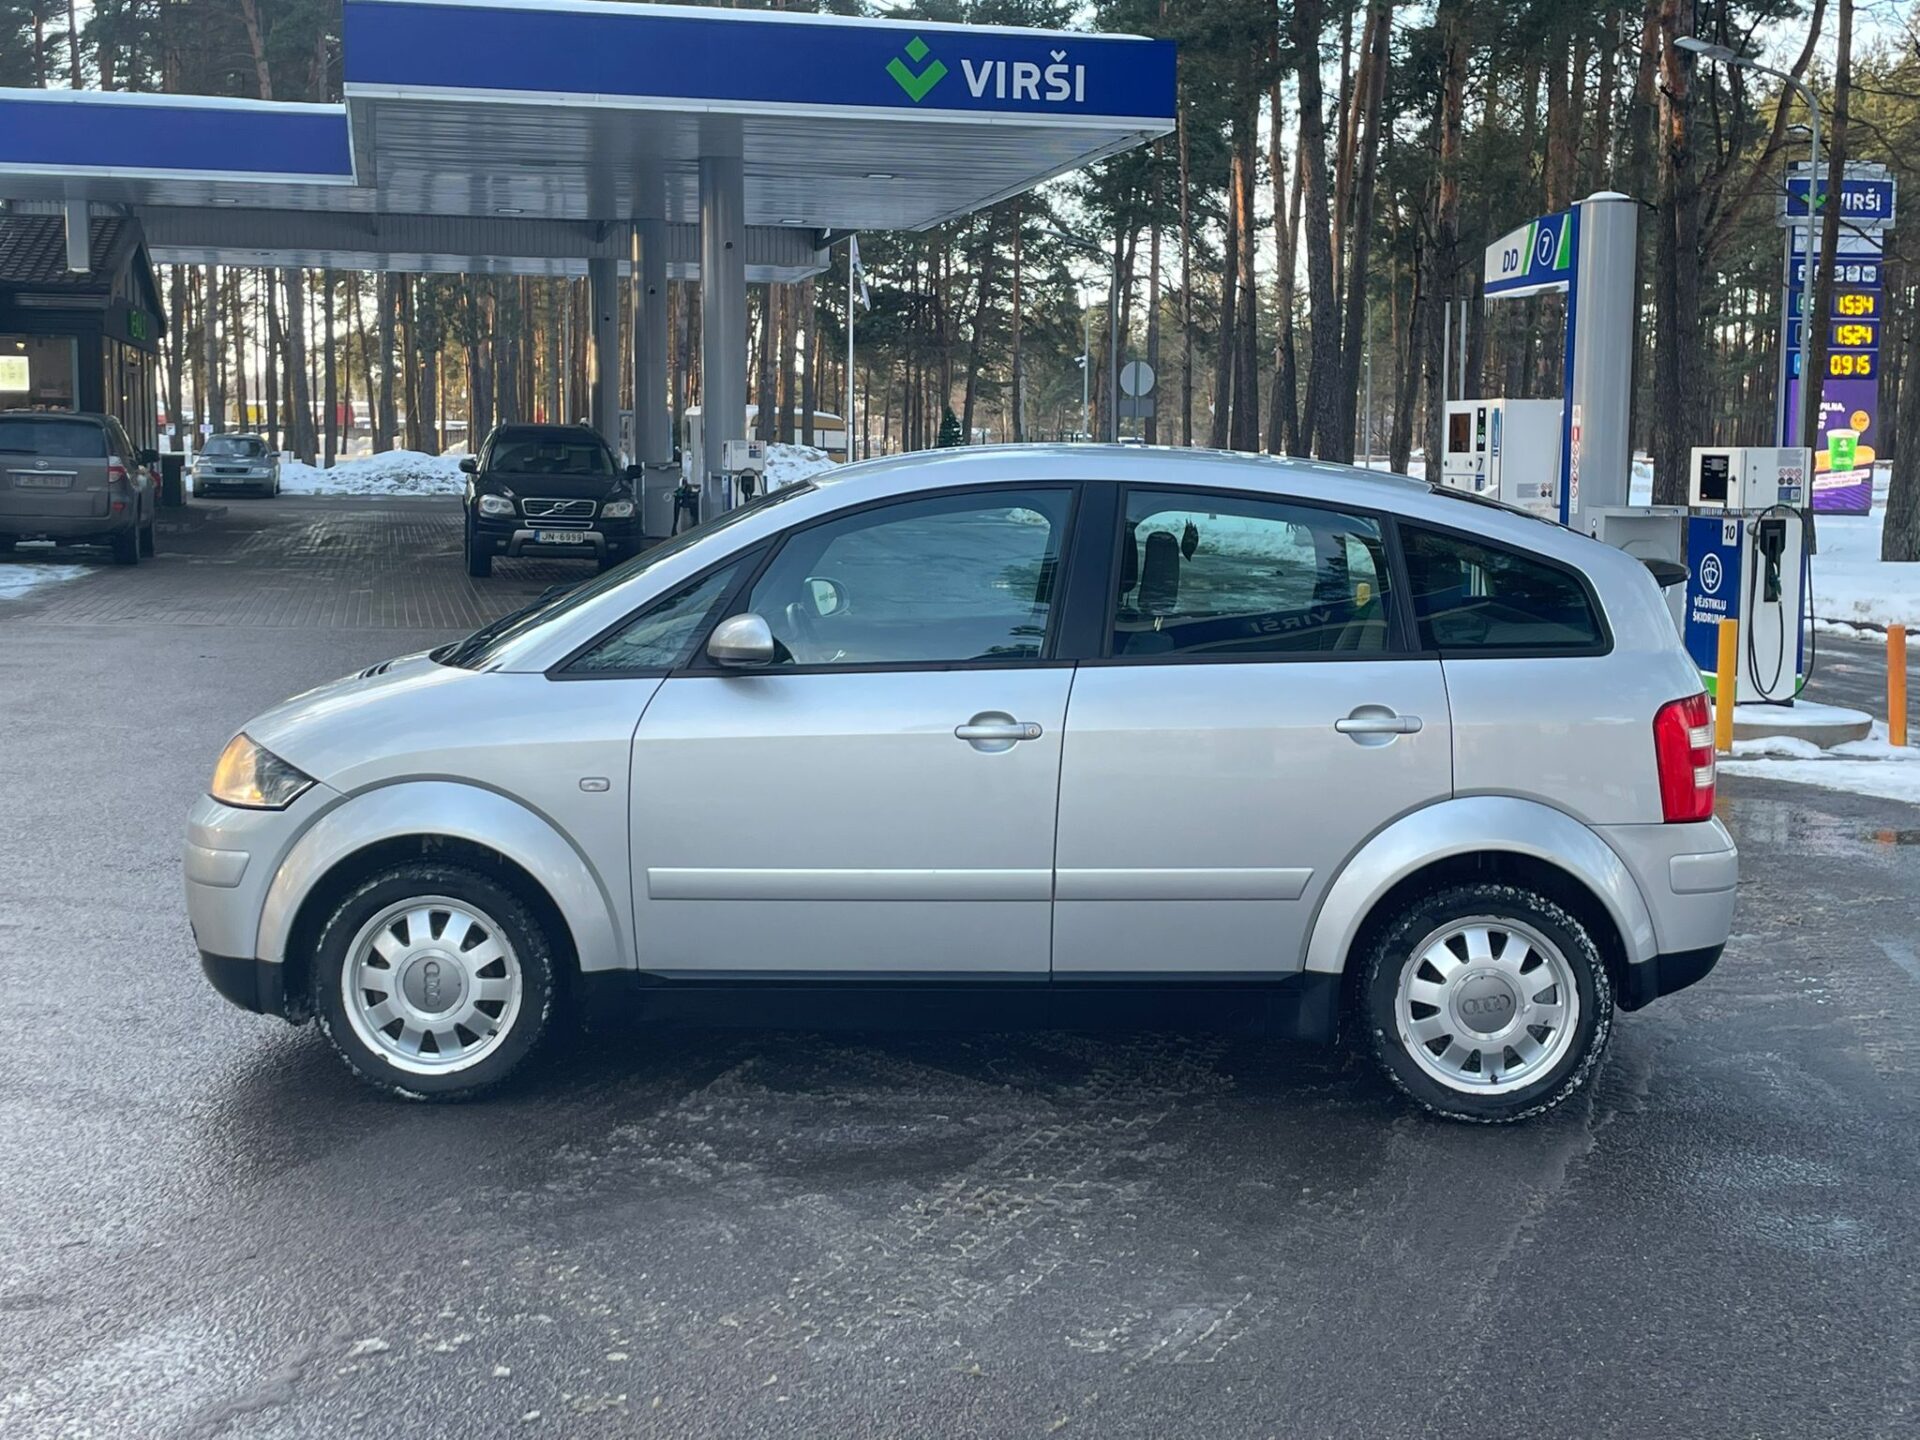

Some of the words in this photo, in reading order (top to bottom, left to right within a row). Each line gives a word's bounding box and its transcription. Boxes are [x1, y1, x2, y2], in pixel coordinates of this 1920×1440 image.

[960, 49, 1085, 102] VIRŠI
[1502, 249, 1518, 273] DD
[1541, 236, 1549, 258] 7
[1478, 458, 1483, 471] 7
[1725, 525, 1735, 540] 10
[1694, 594, 1726, 610] VĒJSTIKLU
